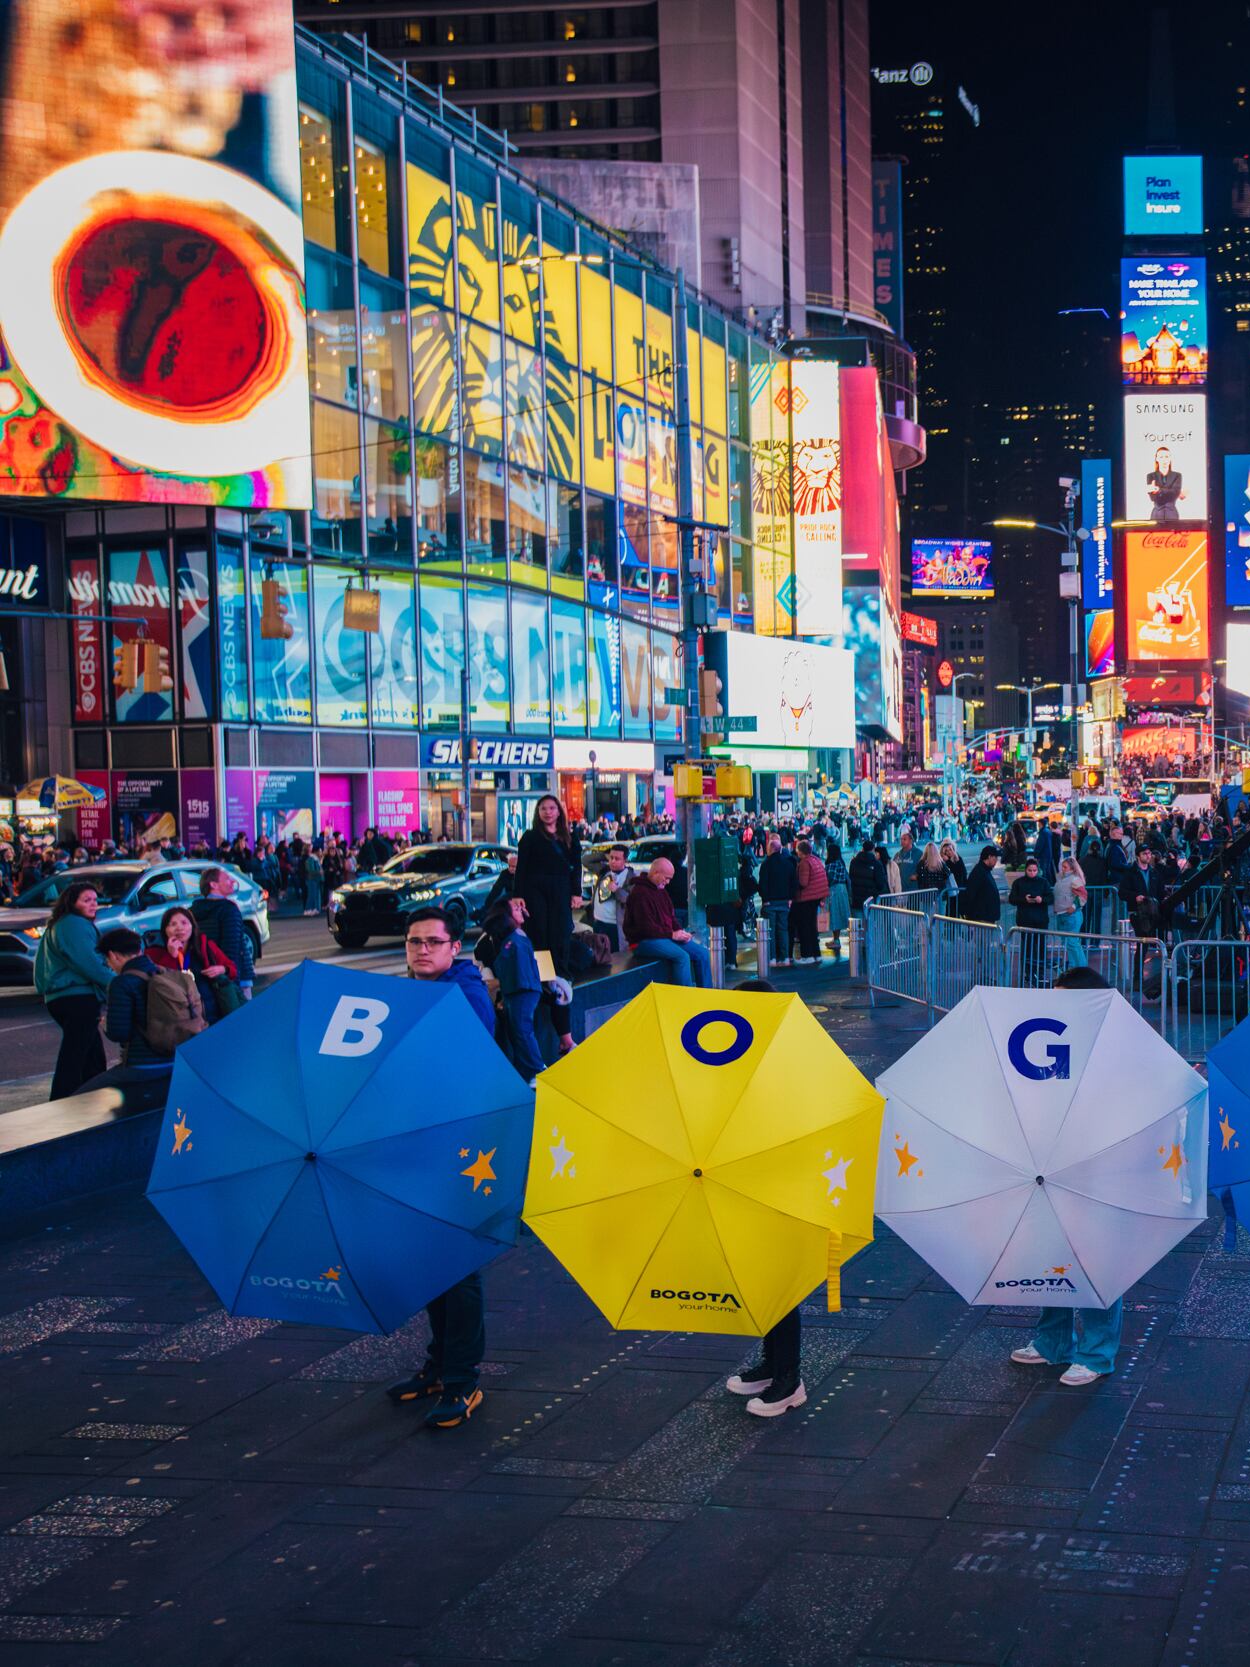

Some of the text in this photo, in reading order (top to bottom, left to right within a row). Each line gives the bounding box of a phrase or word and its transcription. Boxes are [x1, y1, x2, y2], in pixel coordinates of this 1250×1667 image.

[1146, 176, 1171, 188] Plan
[1146, 190, 1180, 201] Invest
[1146, 203, 1181, 214] Insure
[874, 179, 894, 305] TIMES
[633, 336, 673, 389] THE
[1136, 404, 1194, 414] SAMSUNG
[1143, 431, 1193, 442] Yourself
[0, 564, 38, 599] nt
[922, 565, 982, 586] Aladdin
[714, 718, 725, 731] W
[730, 718, 744, 731] 44
[187, 800, 209, 814] 1515
[379, 815, 407, 827] FOR LEASE
[319, 995, 390, 1058] B
[680, 1009, 754, 1066] O
[1008, 1018, 1070, 1080] G
[679, 1303, 738, 1313] your home
